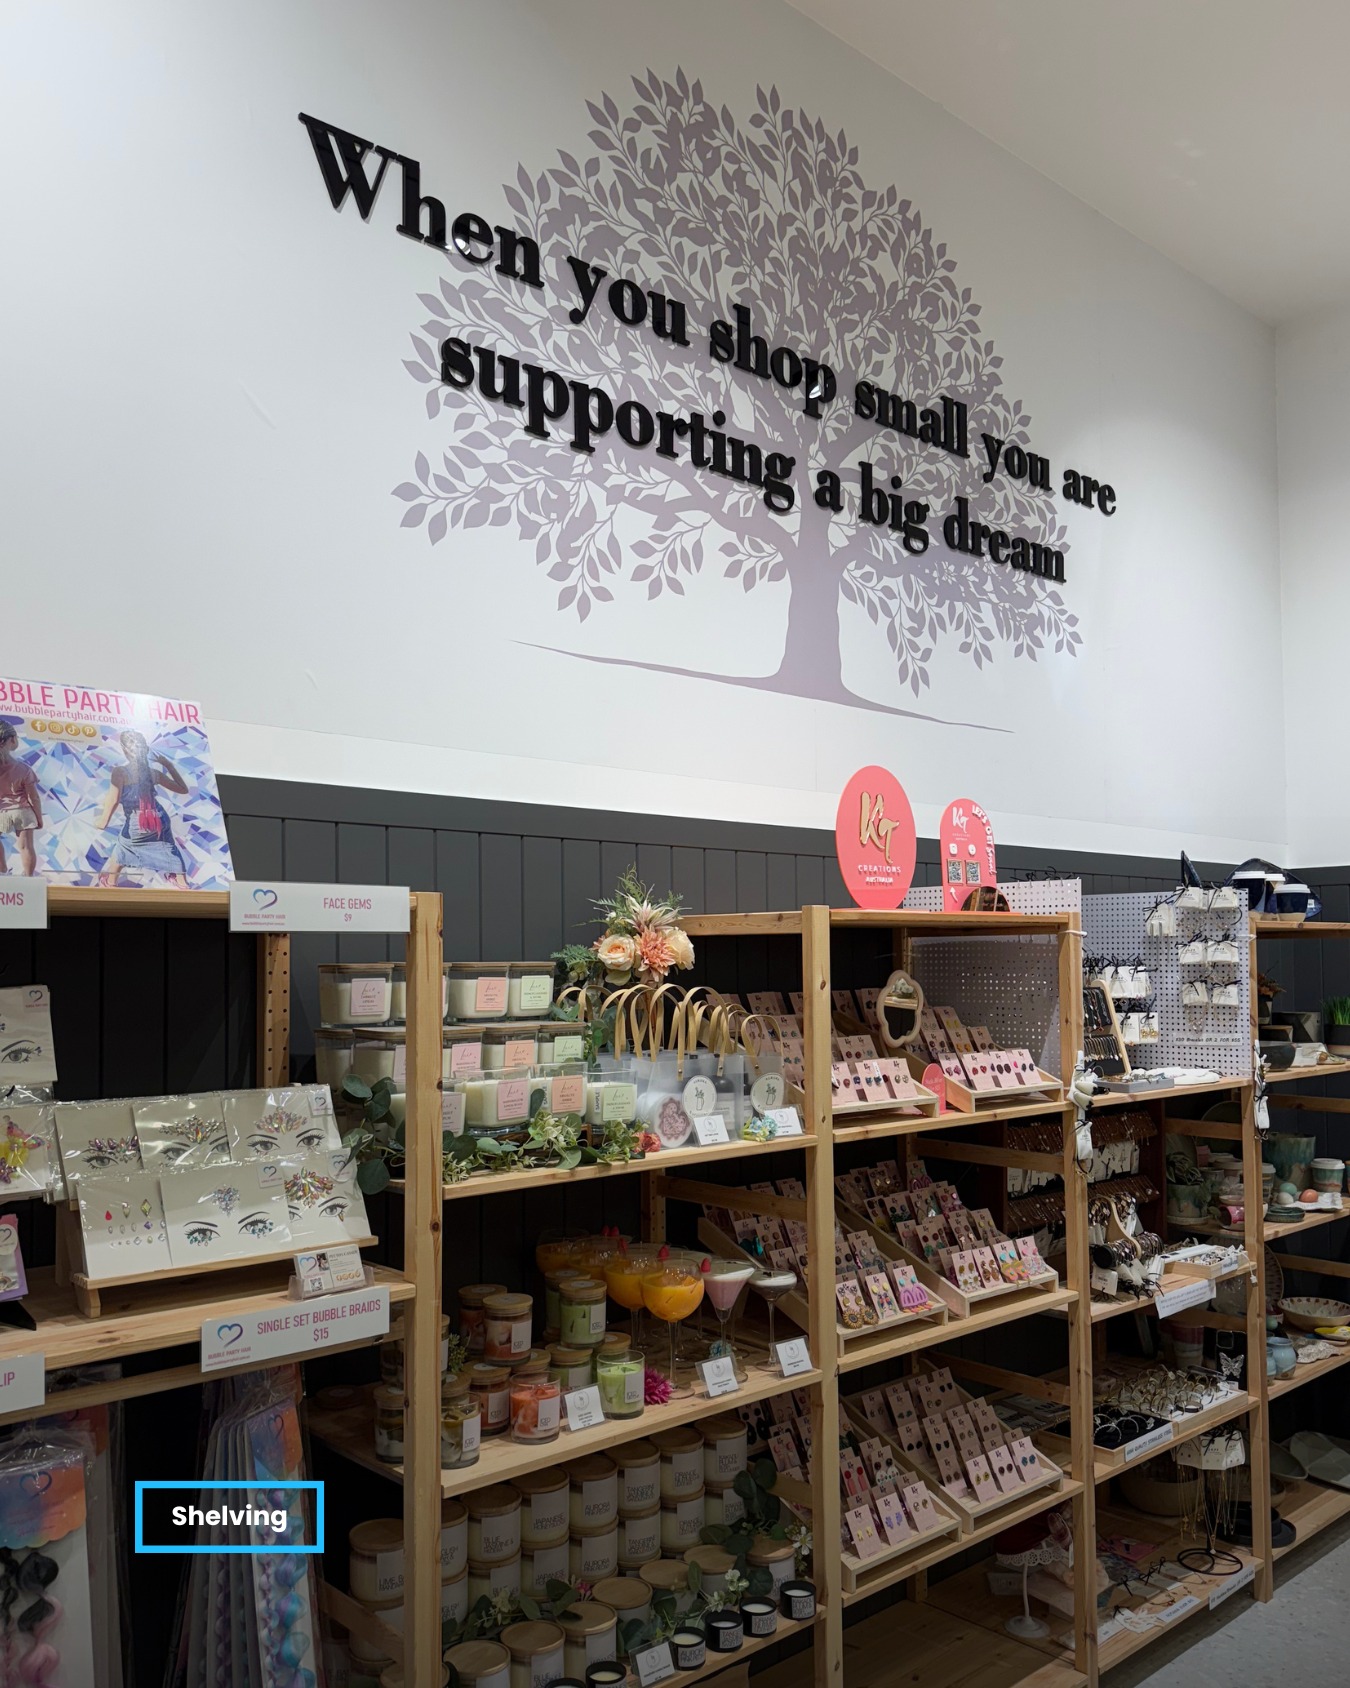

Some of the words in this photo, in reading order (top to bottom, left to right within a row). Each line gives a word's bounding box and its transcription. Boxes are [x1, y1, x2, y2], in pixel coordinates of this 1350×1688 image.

[299, 113, 544, 289] When
[567, 256, 690, 347] you
[710, 303, 836, 420] shop
[855, 381, 970, 458] small
[981, 433, 1052, 491] you
[1063, 470, 1116, 515] are
[441, 338, 796, 513] supporting
[815, 470, 843, 513] a
[859, 461, 930, 554] big
[943, 496, 1066, 583] dream
[64, 688, 136, 715] PARTY
[149, 701, 200, 725] HAIR
[858, 864, 901, 874] CREATIONS
[866, 876, 894, 884] AUSTRALIA
[324, 898, 346, 910] FACE
[348, 898, 372, 910] GEMS
[344, 913, 352, 922] $9
[257, 1316, 290, 1334] SINGLE
[294, 1313, 310, 1326] SET
[313, 1306, 346, 1324] BUBBLE
[349, 1299, 381, 1316] BRAIDS
[313, 1327, 329, 1342] $15
[585, 1502, 610, 1513] AURORA
[534, 1513, 564, 1524] JAPANESE
[584, 1558, 610, 1568] AURORA
